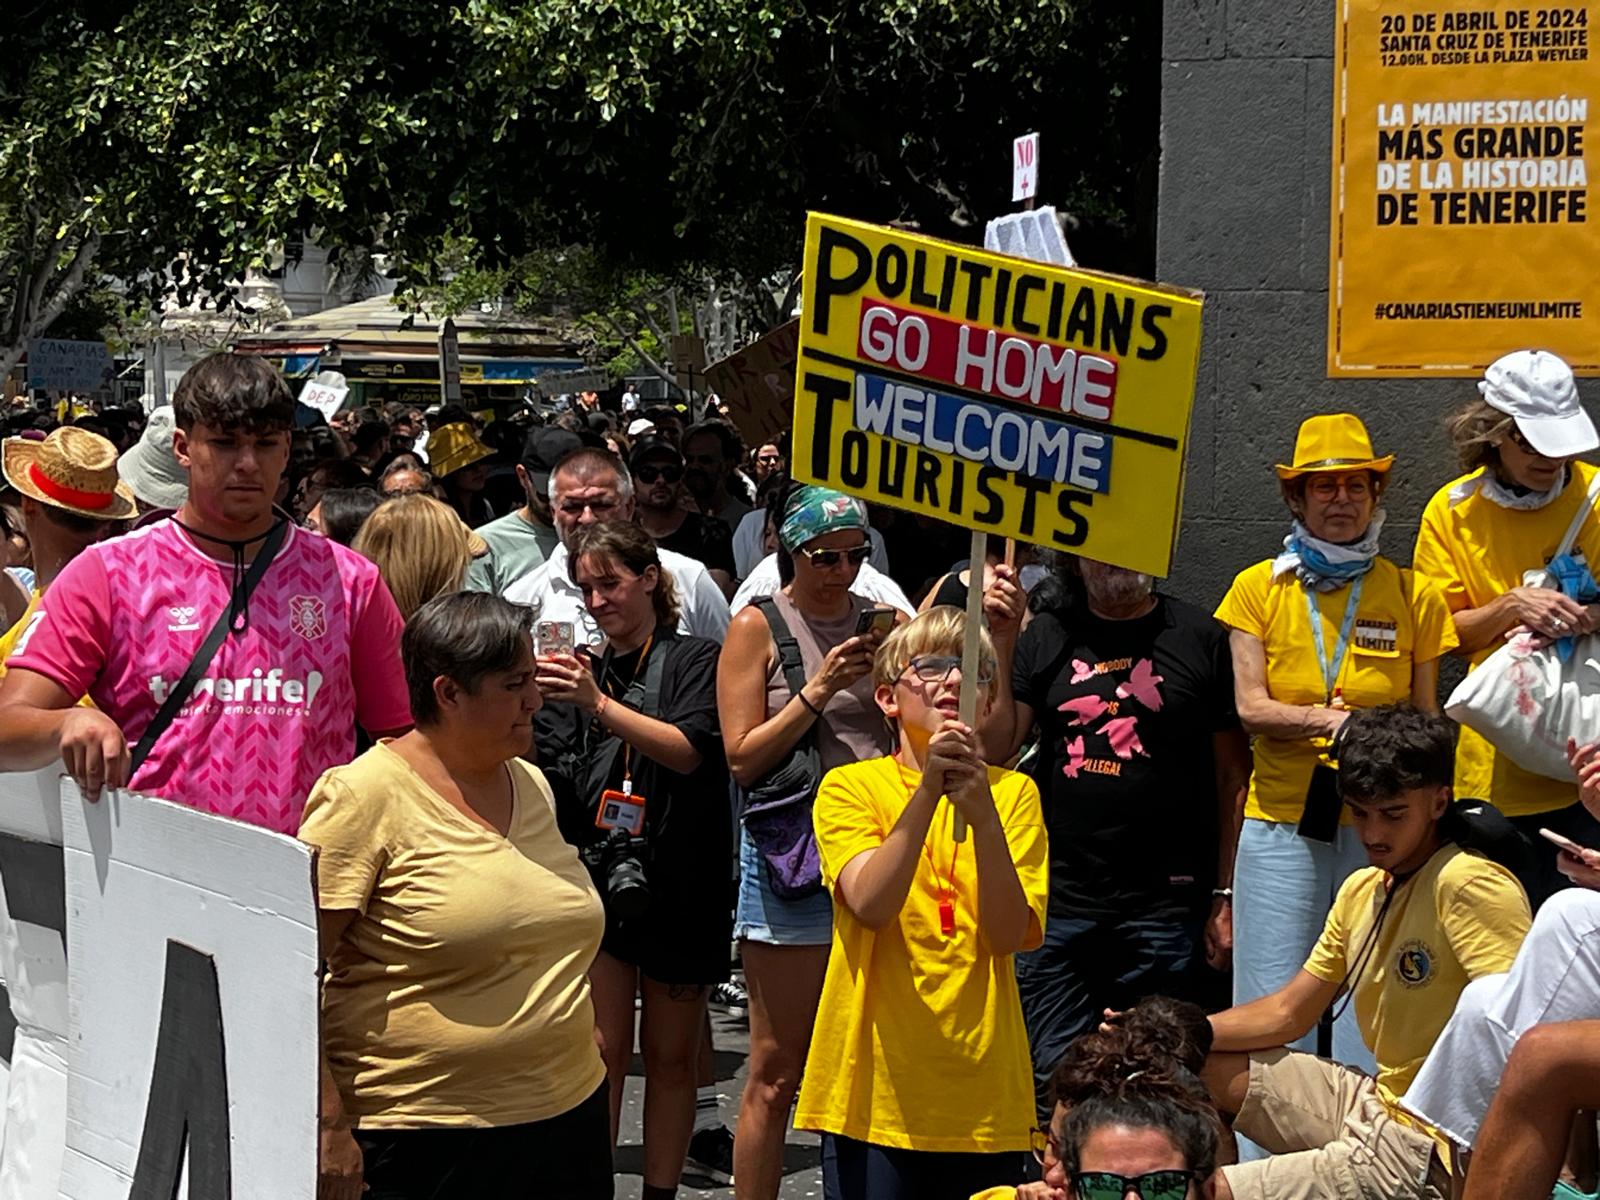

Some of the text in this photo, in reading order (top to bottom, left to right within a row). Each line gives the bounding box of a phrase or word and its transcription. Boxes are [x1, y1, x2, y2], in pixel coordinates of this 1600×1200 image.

[1382, 9, 1587, 33] 20 DE ABRIL DE 2024
[1380, 30, 1587, 52] SANTA CRUZ DE TENERIFE
[1382, 48, 1588, 66] 12.00H. DESDE LA PLAZA WEYLER
[1377, 94, 1588, 126] LA MANIFESTACIÓN
[1016, 138, 1034, 170] NO
[1378, 124, 1583, 160] MÁS GRANDE
[1377, 159, 1588, 190] DE LA HISTORIA
[1377, 190, 1586, 226] DE TENERIFE
[813, 226, 1173, 361] POLITICIANS
[1375, 302, 1582, 320] #CANARIASTIENEUNLIMITE
[861, 306, 930, 371] GO
[954, 324, 1115, 421] HOME
[855, 374, 1105, 491] WELCOME
[804, 373, 1094, 547] TOURISTS
[1094, 657, 1133, 674] NOBODY
[1084, 758, 1121, 777] ILLEGAL
